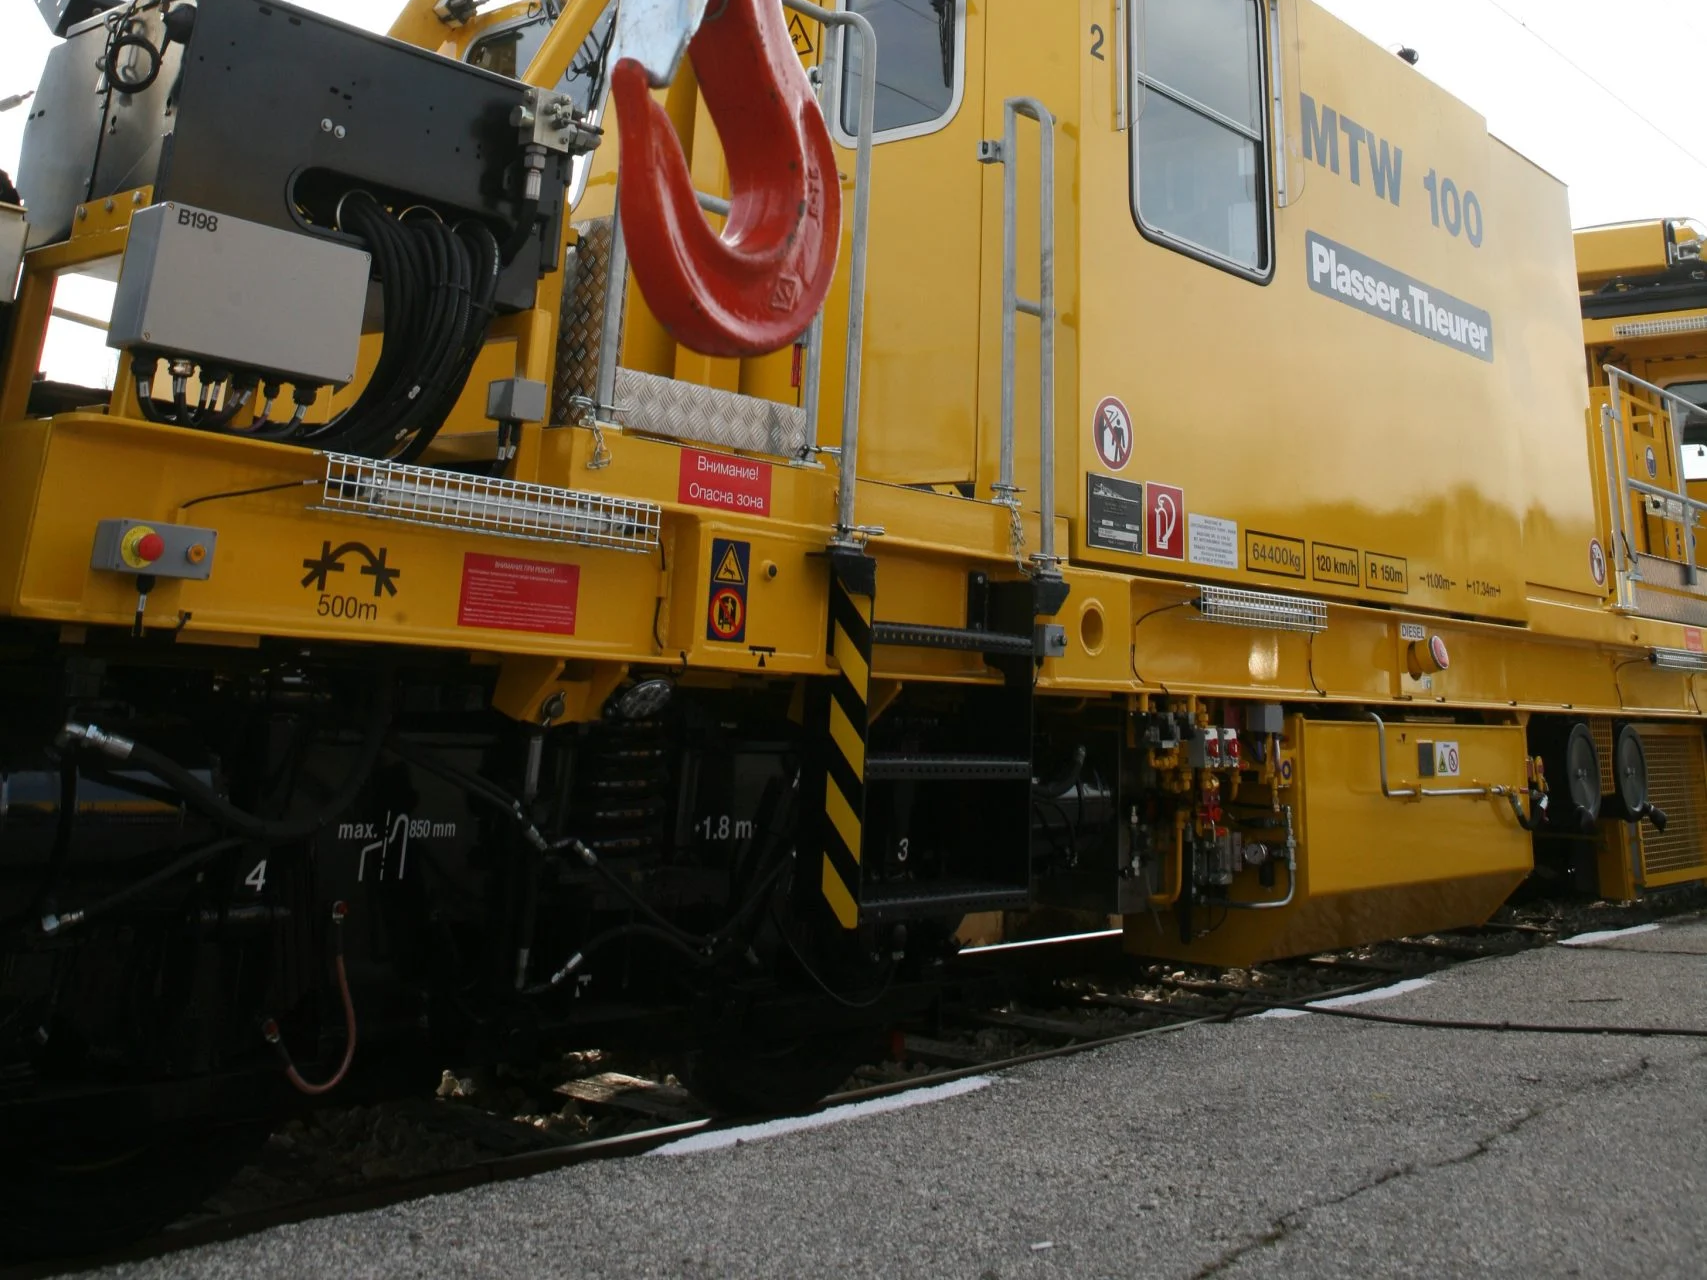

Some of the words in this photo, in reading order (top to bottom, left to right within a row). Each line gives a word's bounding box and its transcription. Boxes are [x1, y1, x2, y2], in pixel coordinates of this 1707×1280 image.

[1090, 24, 1104, 61] 2
[1300, 91, 1402, 207] MTW
[1423, 168, 1483, 248] 100
[178, 208, 218, 232] B198
[1312, 240, 1400, 315] Plasser
[1409, 284, 1488, 352] Theurer
[697, 455, 759, 480] Внимание!
[689, 482, 734, 504] Опасна
[736, 494, 763, 509] зона
[1316, 554, 1331, 573] 120
[1333, 556, 1357, 577] km/h
[1370, 562, 1377, 579] R
[1381, 565, 1403, 583] 150m
[317, 593, 377, 620] 500m
[1402, 624, 1424, 639] DIESEL
[338, 822, 378, 839] max.
[409, 819, 431, 838] 850
[432, 822, 456, 838] mm
[735, 820, 752, 839] m
[897, 837, 909, 861] 3
[245, 859, 267, 891] 4
